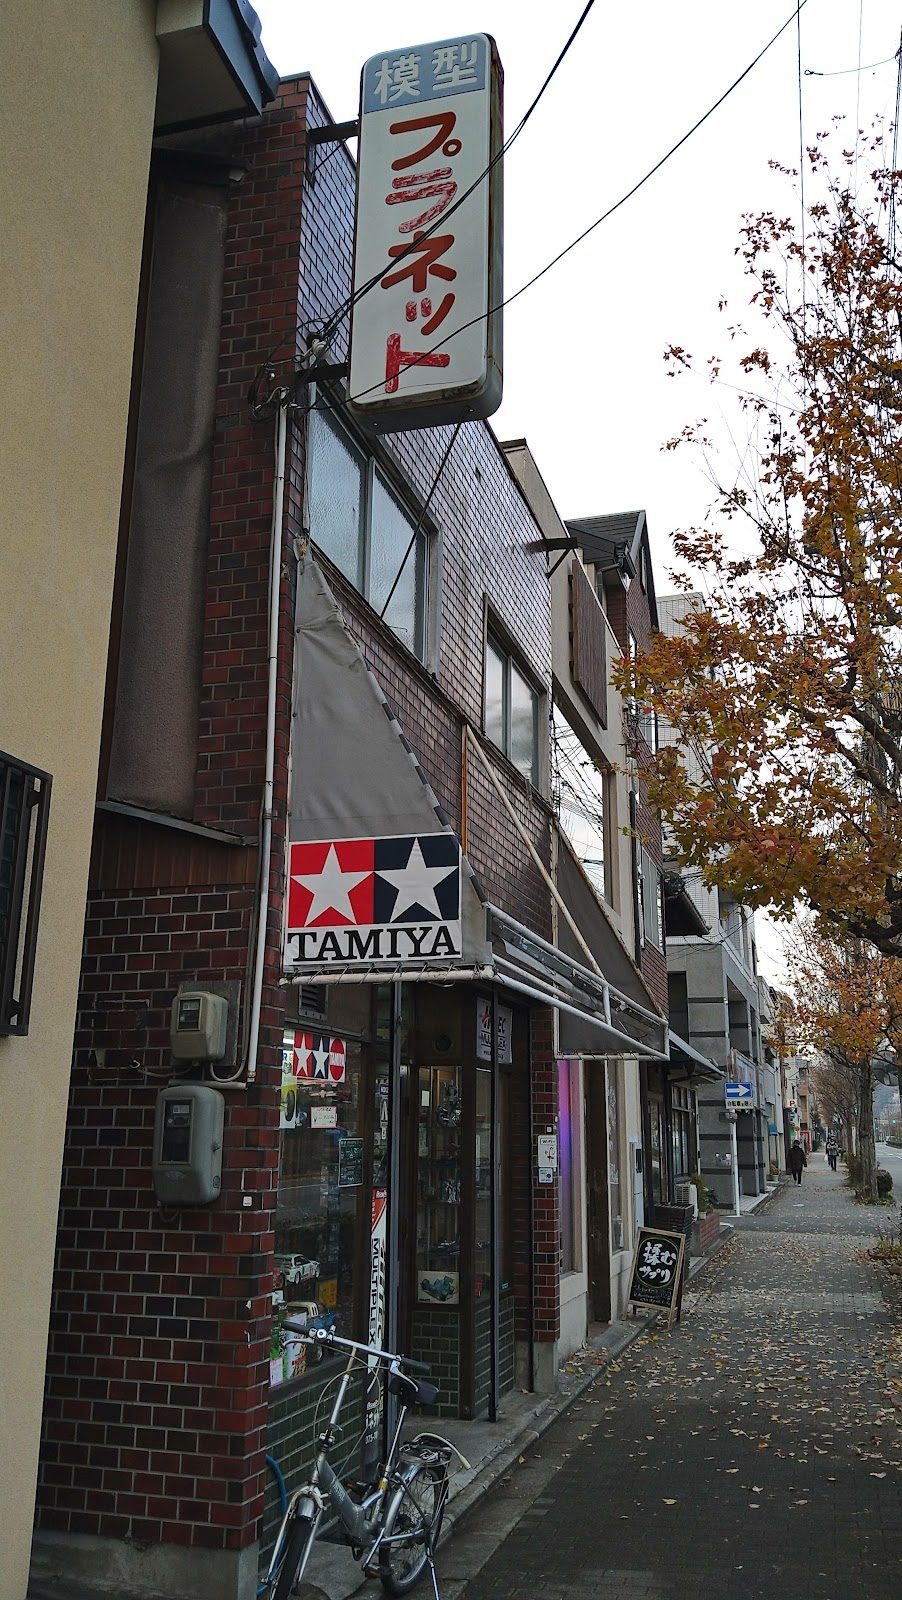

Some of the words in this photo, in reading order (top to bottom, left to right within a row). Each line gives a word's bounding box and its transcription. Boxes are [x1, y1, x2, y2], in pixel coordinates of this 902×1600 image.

[374, 41, 479, 104] 模型
[380, 111, 463, 394] プラネット
[288, 925, 460, 962] TAMIYA
[639, 1265, 671, 1284] サプリ
[643, 1242, 677, 1266] 揉む
[369, 1238, 380, 1343] MULTIPLEX
